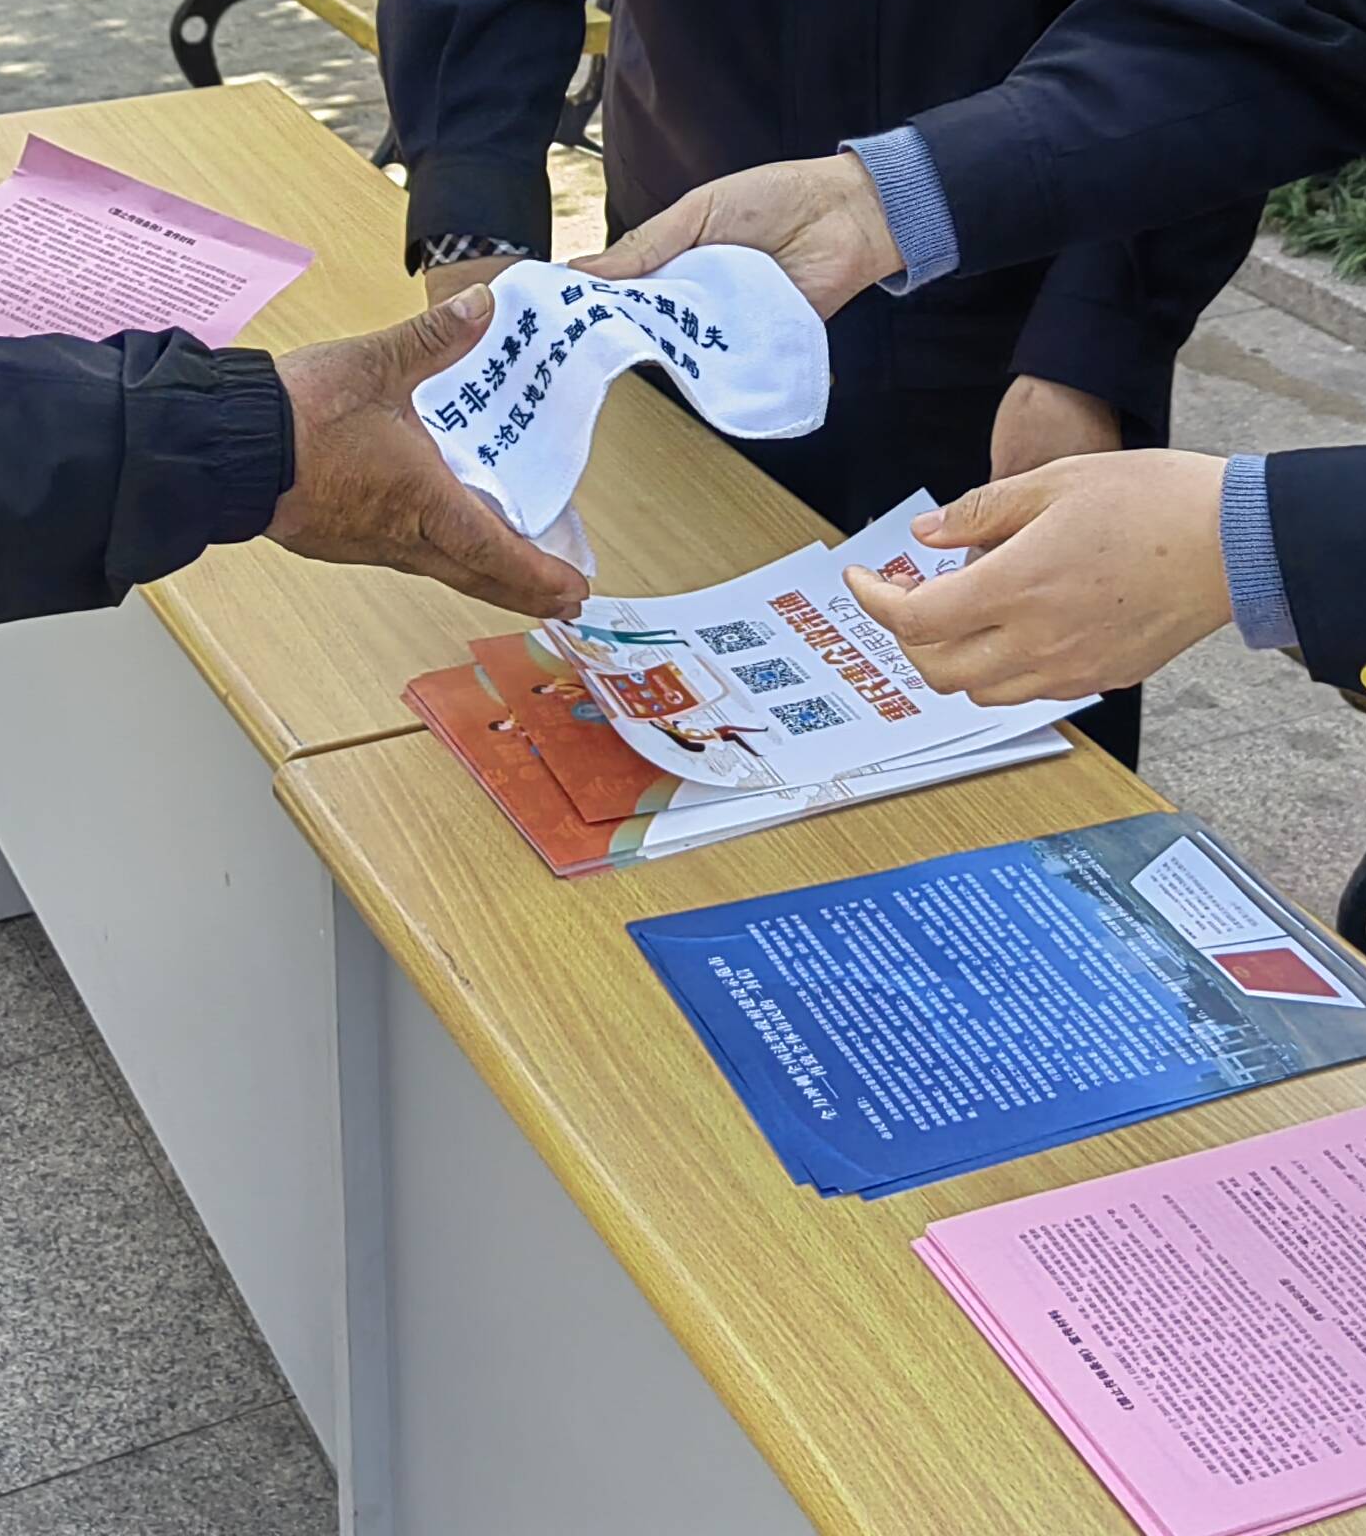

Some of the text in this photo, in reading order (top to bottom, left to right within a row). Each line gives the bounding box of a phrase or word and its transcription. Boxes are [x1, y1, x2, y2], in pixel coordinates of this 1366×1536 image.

[421, 306, 541, 434] 与非法集资
[766, 589, 923, 723] 惠民惠企政策通
